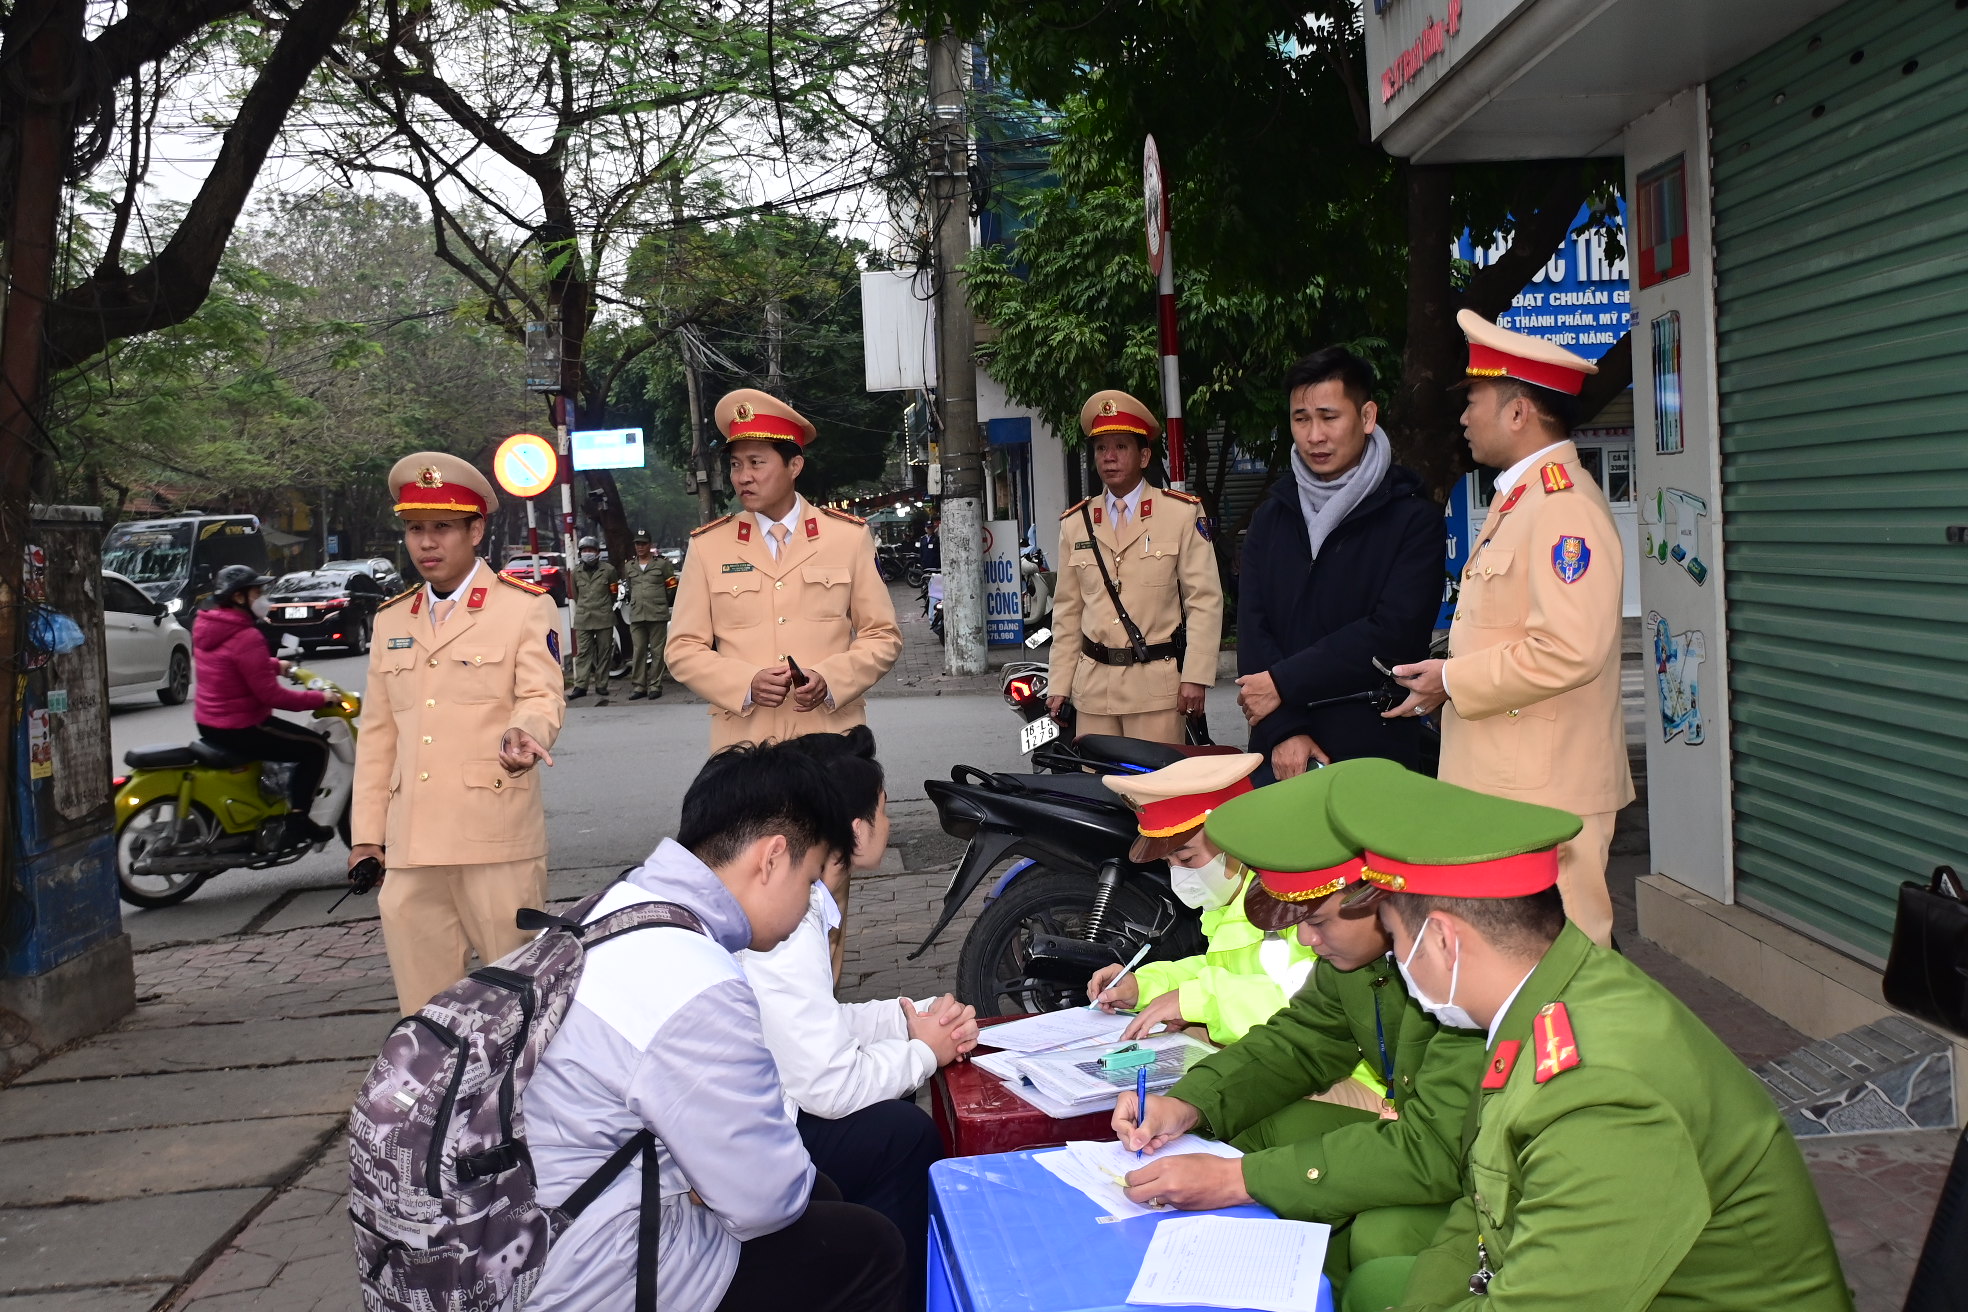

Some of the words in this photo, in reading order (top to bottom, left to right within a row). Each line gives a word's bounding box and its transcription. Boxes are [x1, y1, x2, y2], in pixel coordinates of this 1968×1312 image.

[1512, 293, 1545, 310] ĐẠT
[1549, 286, 1608, 306] CHUẨN
[1514, 313, 1555, 328] THÀNH
[1557, 309, 1596, 327] PHẨM,
[1599, 311, 1618, 325] MỸ
[1579, 331, 1617, 345] NĂNG,
[987, 587, 1019, 616] CÔNG
